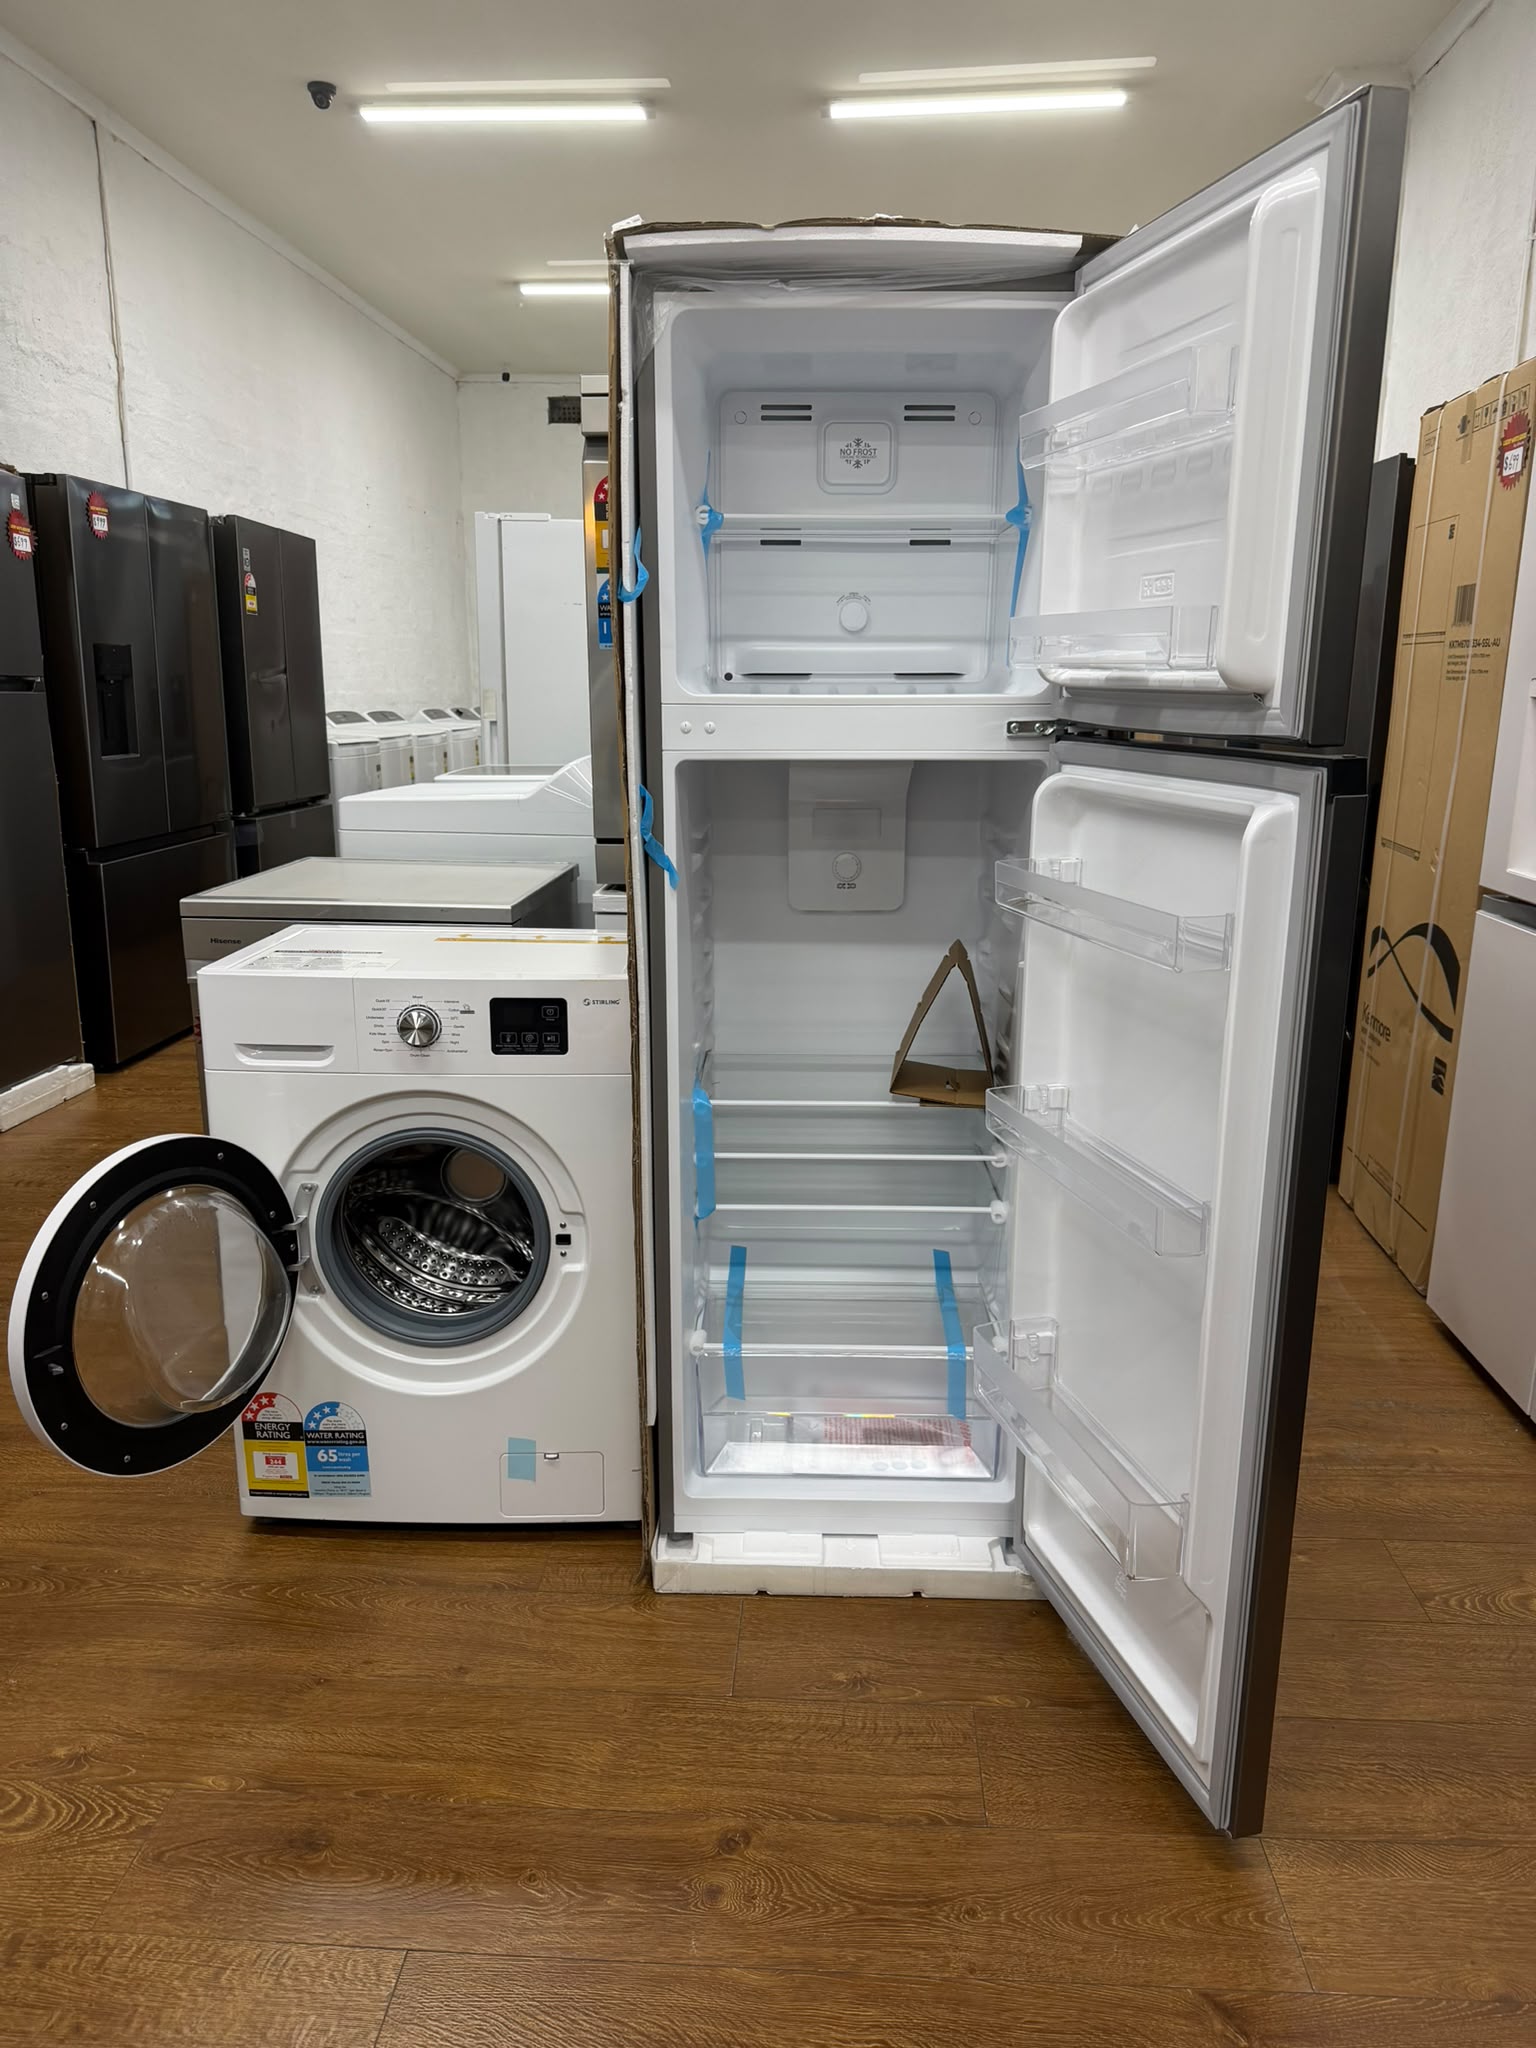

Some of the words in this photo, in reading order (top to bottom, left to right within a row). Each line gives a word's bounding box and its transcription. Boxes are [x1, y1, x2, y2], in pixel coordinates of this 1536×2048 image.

[840, 448, 851, 456] NO
[853, 448, 877, 456] FROST
[1361, 1002, 1391, 1042] Kemore
[254, 1423, 291, 1431] ENERGY
[256, 1431, 291, 1439] RATING
[317, 1449, 338, 1462] 65
